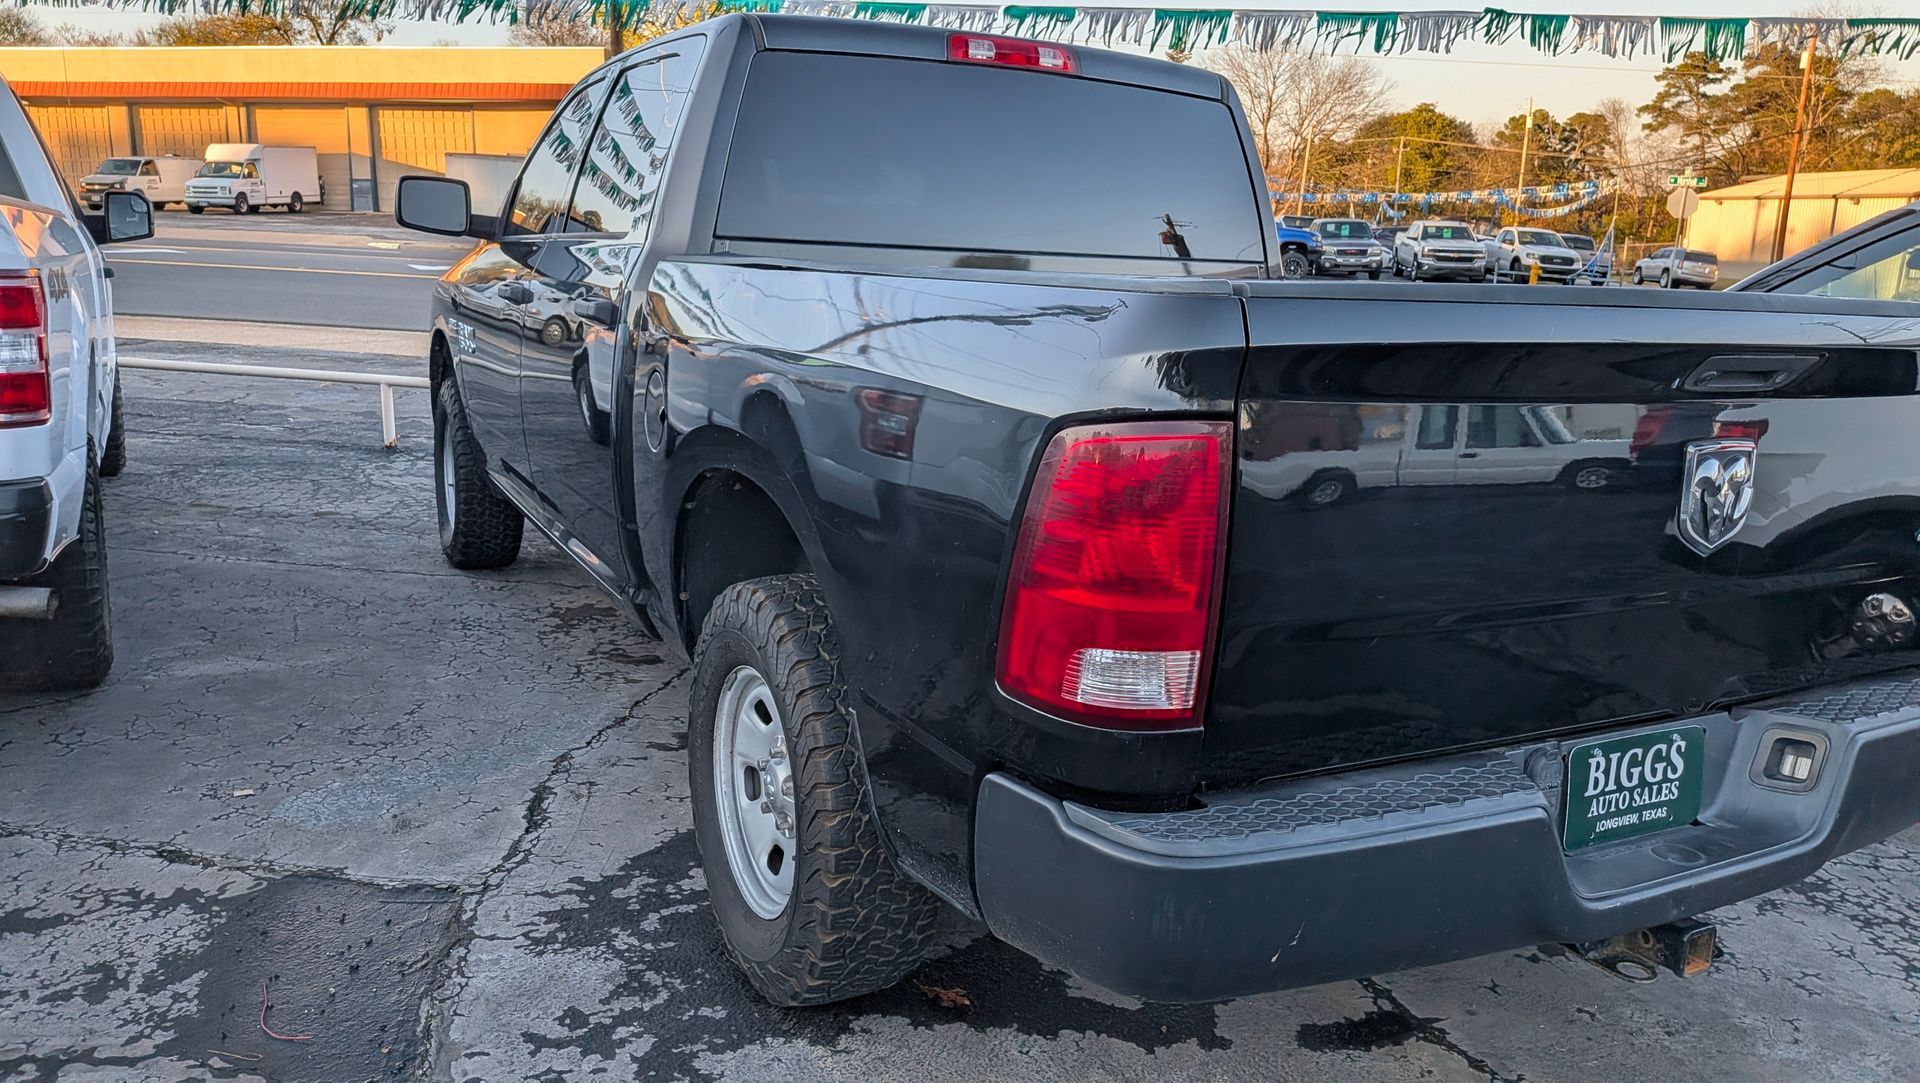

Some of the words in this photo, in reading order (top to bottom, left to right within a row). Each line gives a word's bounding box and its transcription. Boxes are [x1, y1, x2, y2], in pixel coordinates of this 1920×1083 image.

[1584, 741, 1687, 797] BIGGS
[1587, 791, 1629, 818] AUTO
[1632, 781, 1680, 807] SALES
[1596, 813, 1639, 833] LONGVIEW,
[1642, 806, 1668, 822] TEXAS
